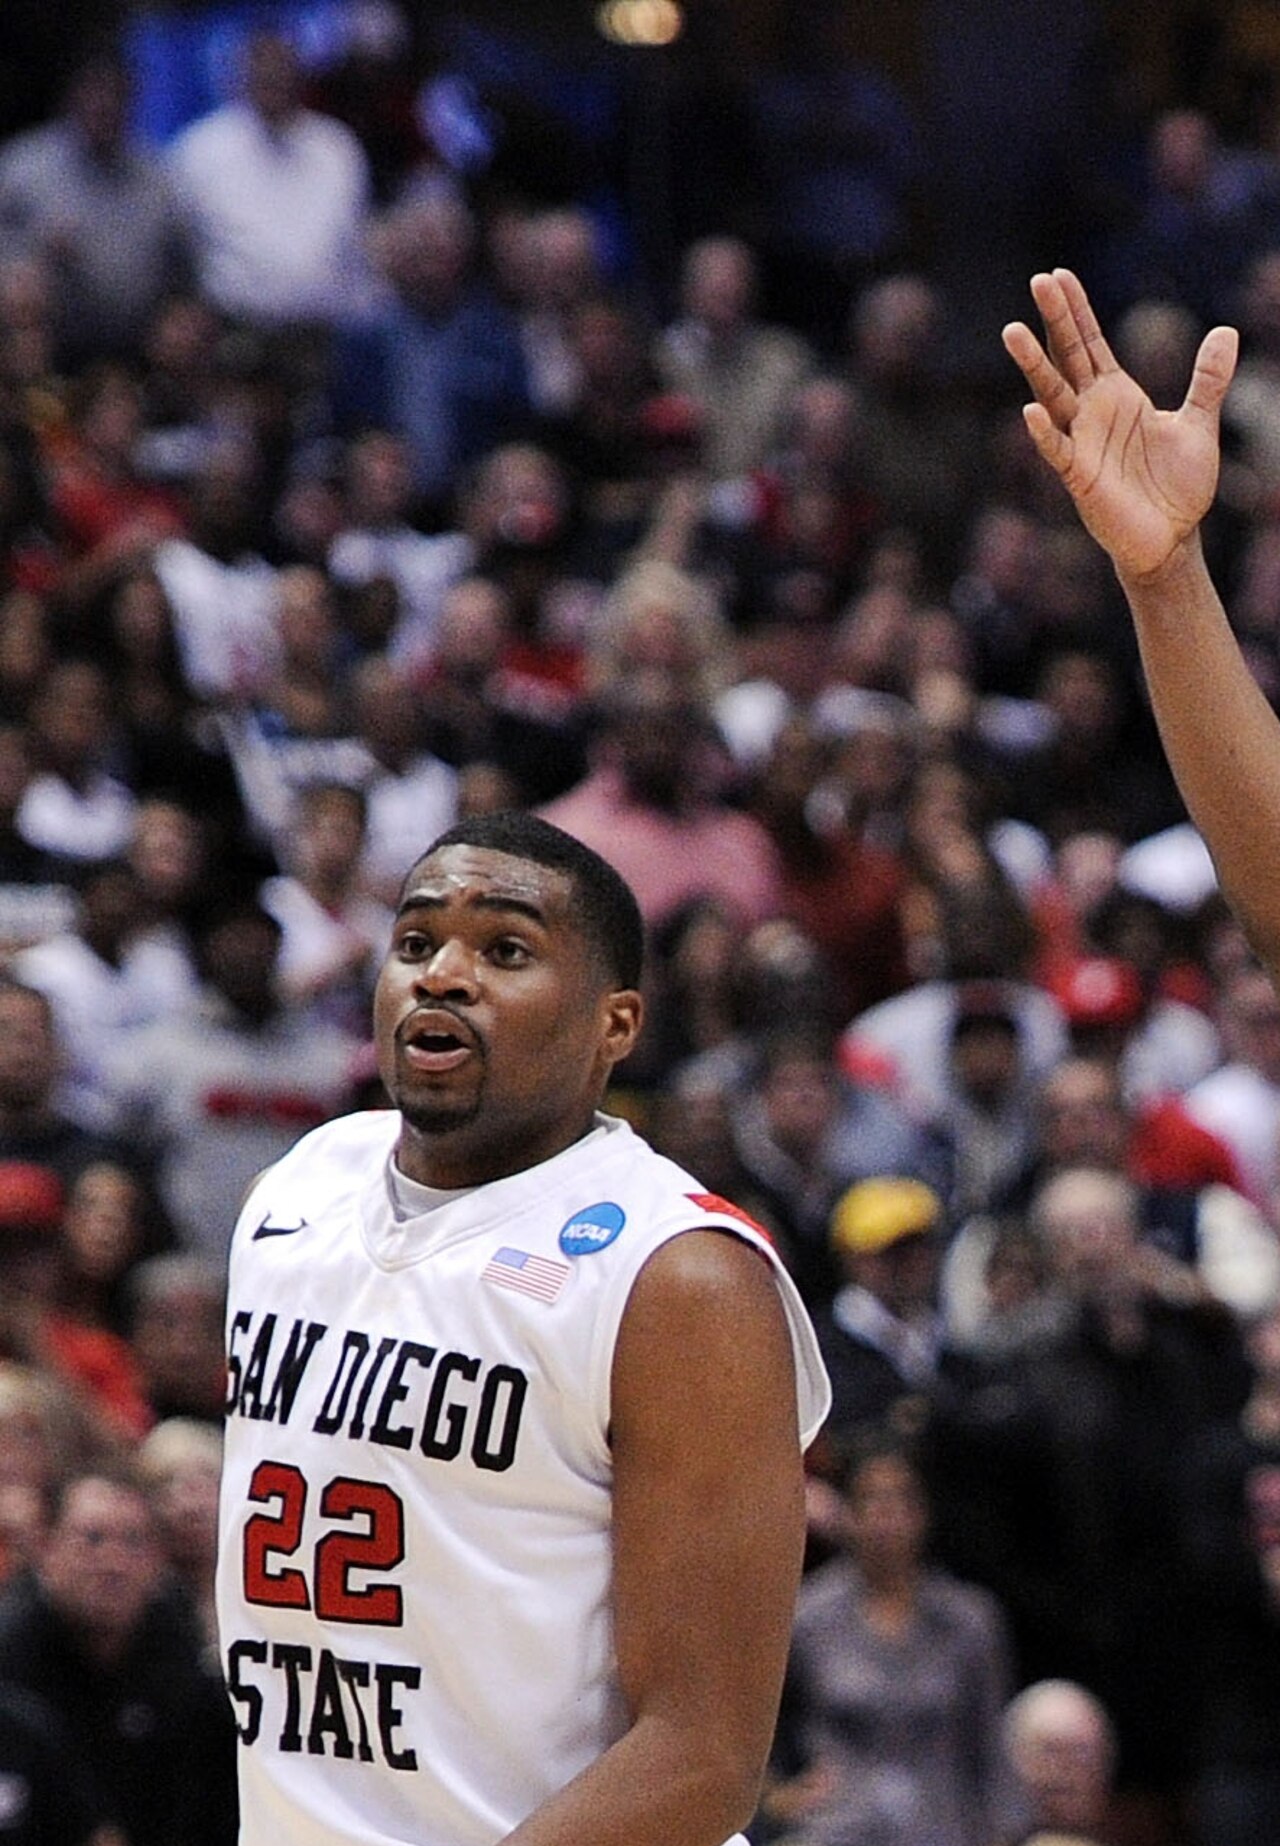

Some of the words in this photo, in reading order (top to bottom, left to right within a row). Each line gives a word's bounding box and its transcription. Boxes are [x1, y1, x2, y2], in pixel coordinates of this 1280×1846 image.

[227, 1311, 328, 1426] SAN
[312, 1330, 528, 1472] DIEGO
[243, 1459, 405, 1628] 22
[227, 1639, 422, 1772] STATE
